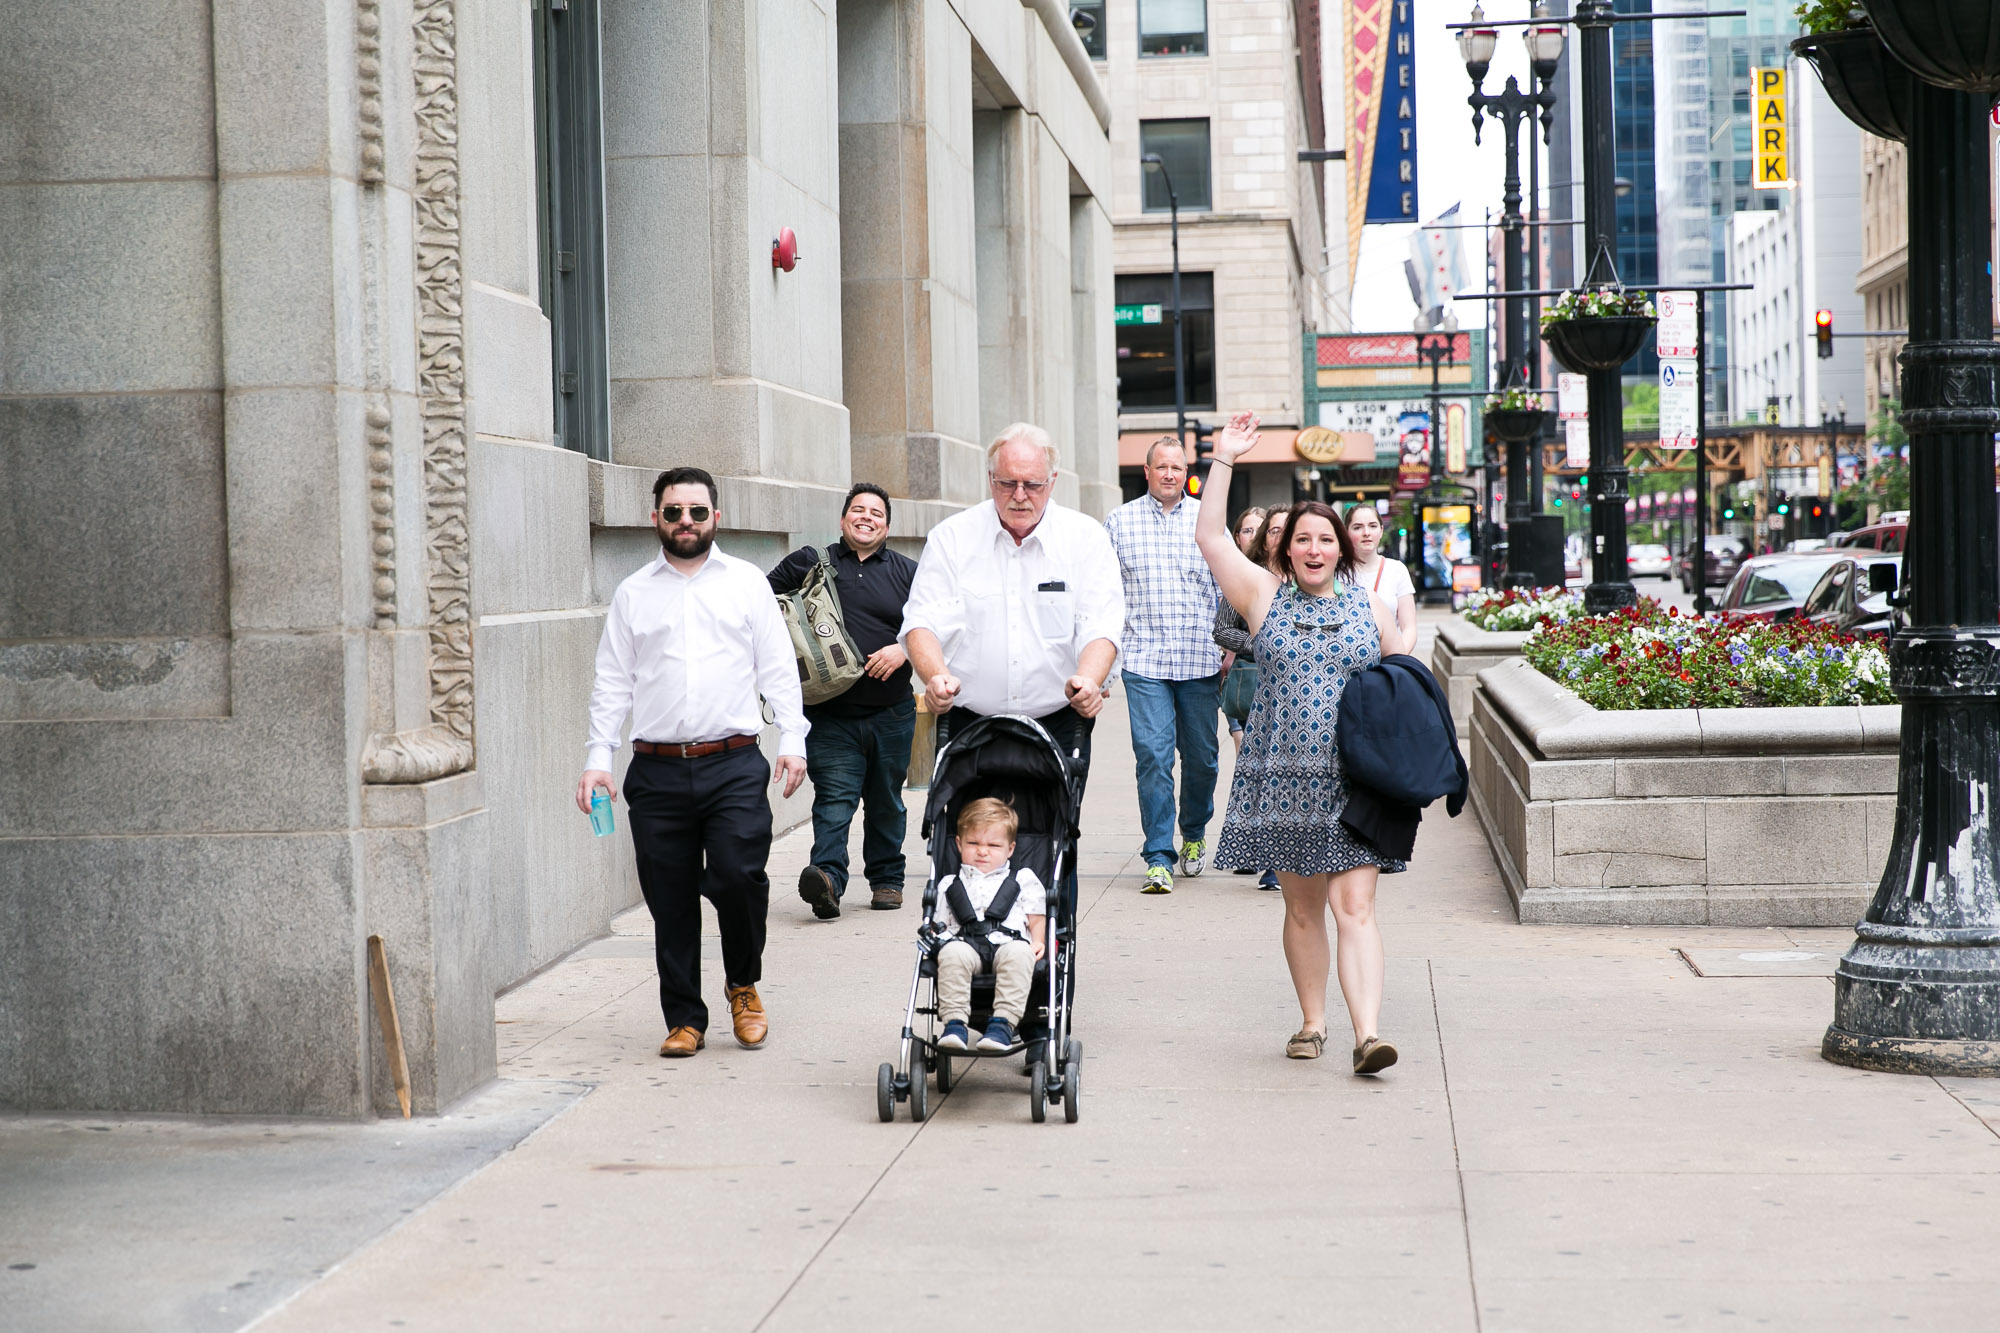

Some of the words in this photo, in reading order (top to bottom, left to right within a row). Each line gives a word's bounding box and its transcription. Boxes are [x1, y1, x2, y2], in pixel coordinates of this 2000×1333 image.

[1397, 2, 1412, 214] THEATRE
[1763, 71, 1782, 180] PARK
[1114, 309, 1133, 320] alle
[1355, 404, 1387, 413] SHOW
[1402, 402, 1447, 412] SEASN
[1348, 416, 1372, 425] NOW
